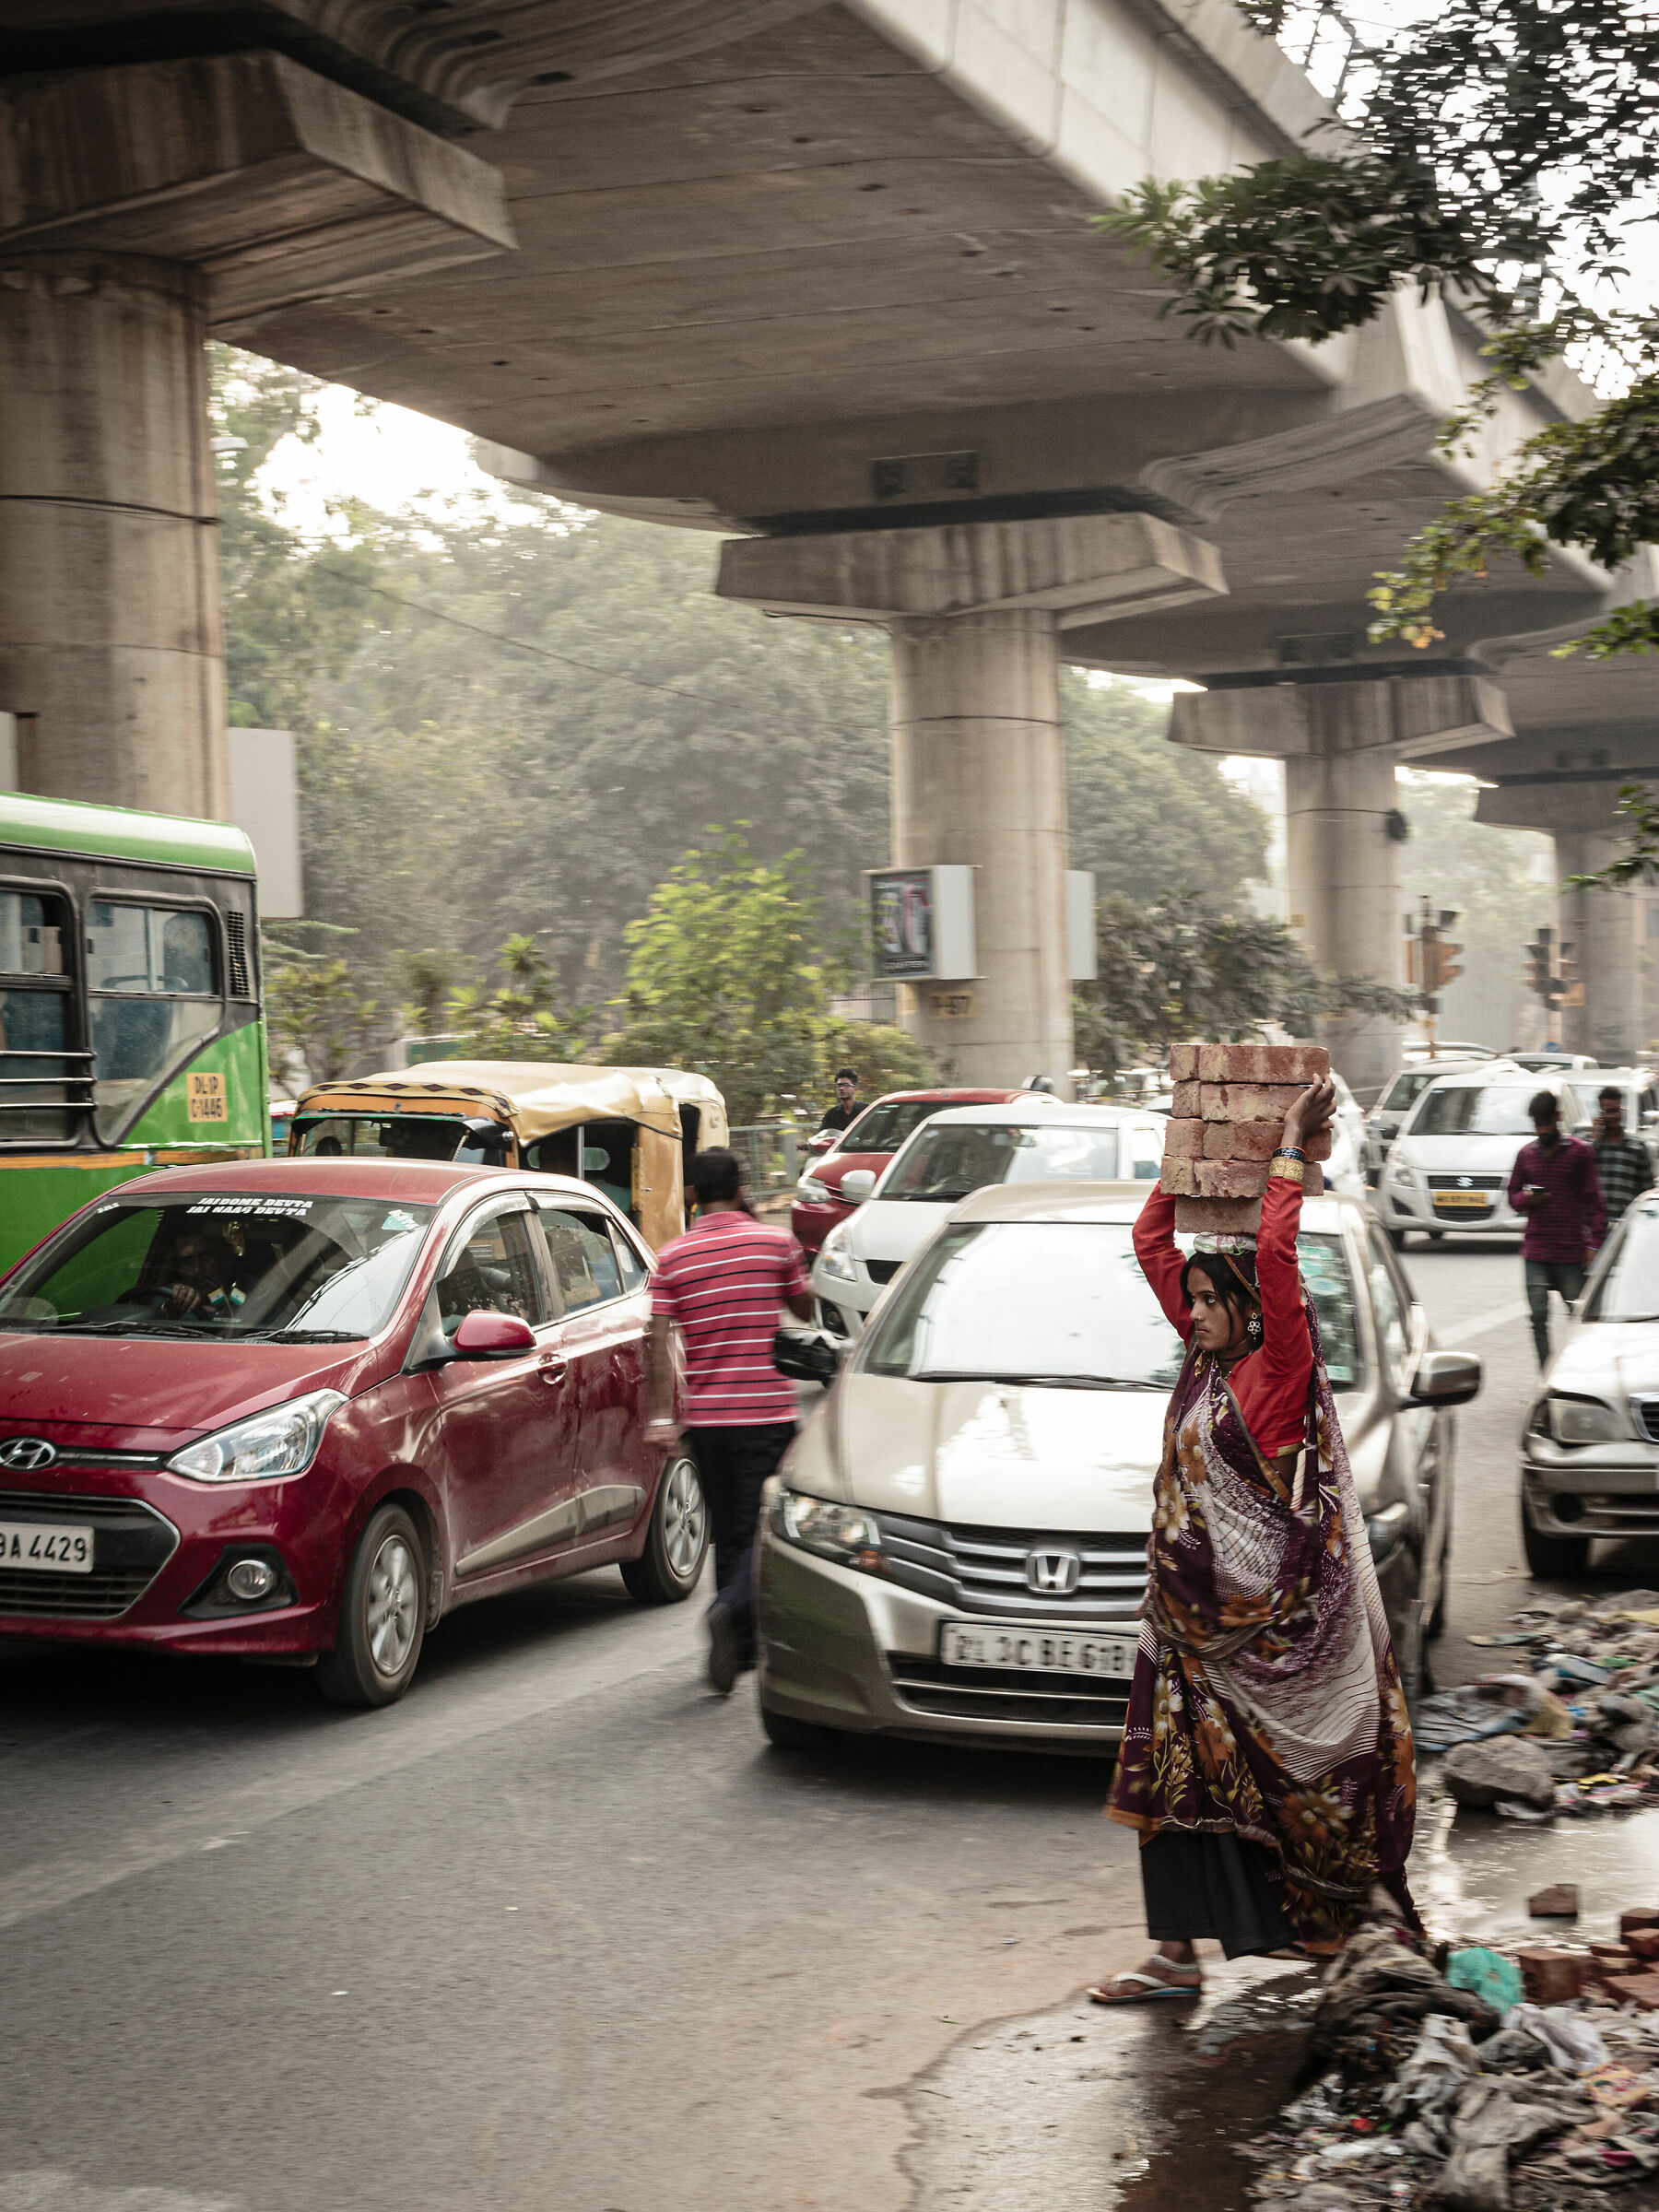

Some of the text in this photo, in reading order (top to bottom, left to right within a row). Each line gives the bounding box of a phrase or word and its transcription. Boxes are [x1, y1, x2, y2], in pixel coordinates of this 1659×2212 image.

[196, 1197, 222, 1206] JAI
[262, 1198, 314, 1208] DEVTA
[185, 1206, 212, 1214] JAI
[253, 1206, 308, 1216] DEVTA
[29, 1534, 88, 1563] 4429
